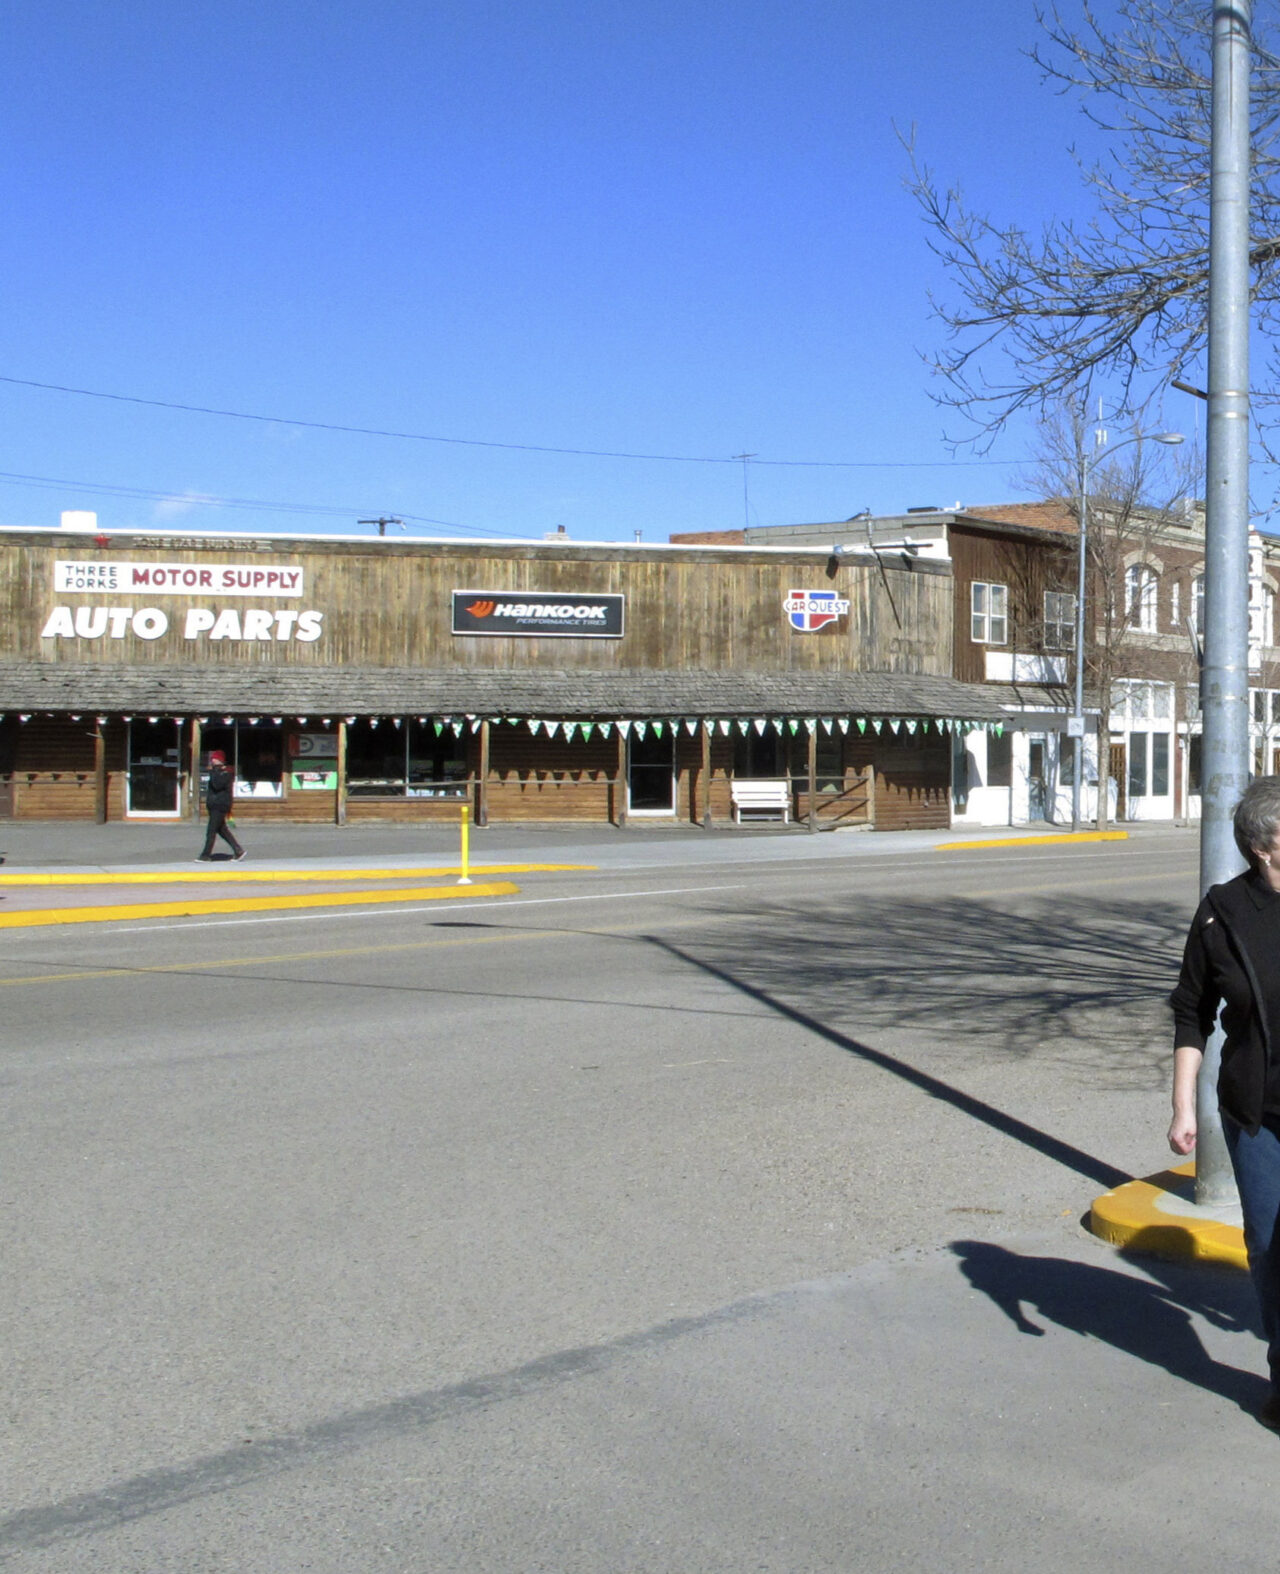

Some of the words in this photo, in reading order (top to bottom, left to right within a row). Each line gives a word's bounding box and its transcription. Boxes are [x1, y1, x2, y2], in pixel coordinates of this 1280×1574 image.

[65, 565, 118, 577] THREE
[65, 578, 118, 590] FORKS
[132, 567, 212, 587] MOTOR
[222, 569, 300, 589] SUPPLY
[41, 606, 169, 640] AUTO
[183, 608, 324, 642] PARTS
[515, 618, 581, 626] PERFORMANCE
[582, 618, 607, 627] TIRES
